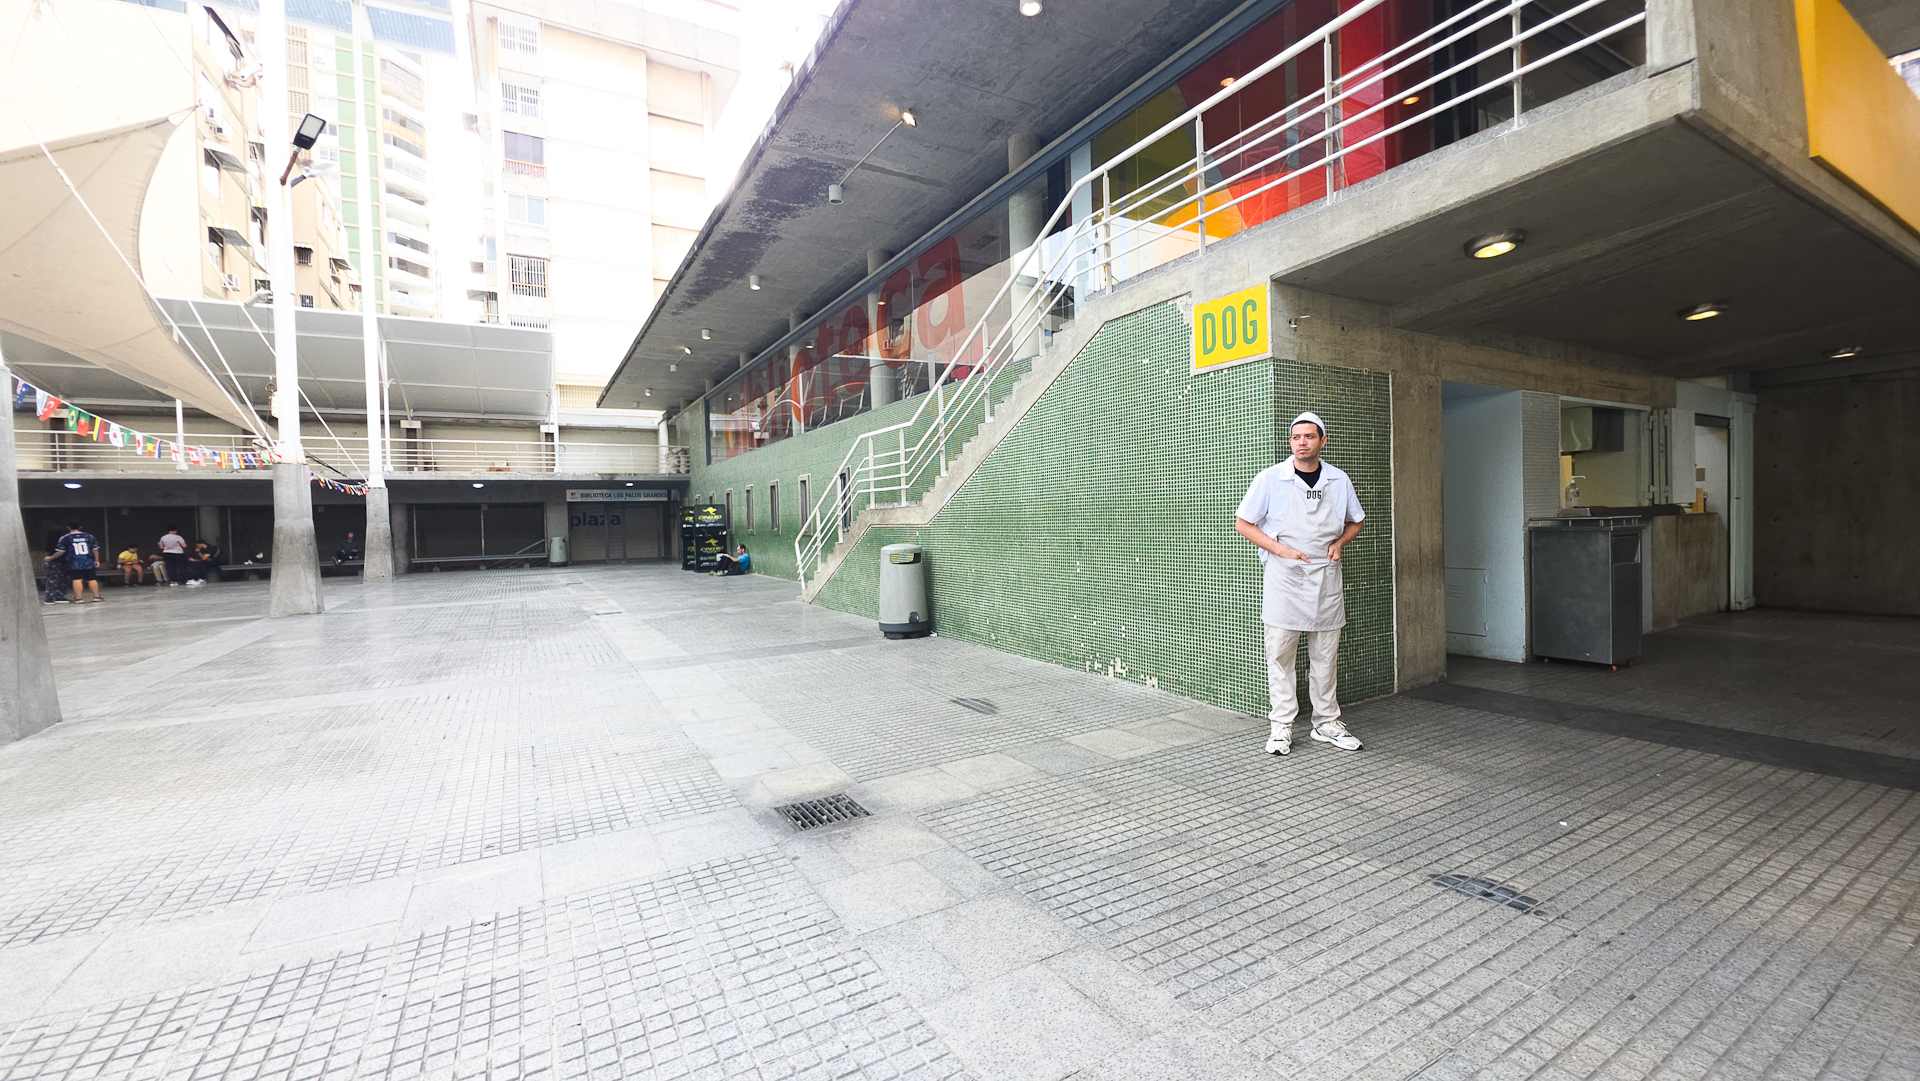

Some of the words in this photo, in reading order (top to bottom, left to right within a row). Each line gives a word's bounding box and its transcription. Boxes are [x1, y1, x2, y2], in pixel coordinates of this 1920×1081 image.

[1202, 299, 1258, 356] DOG
[1306, 490, 1322, 500] DOG
[570, 512, 621, 530] plaza
[72, 542, 89, 556] 10
